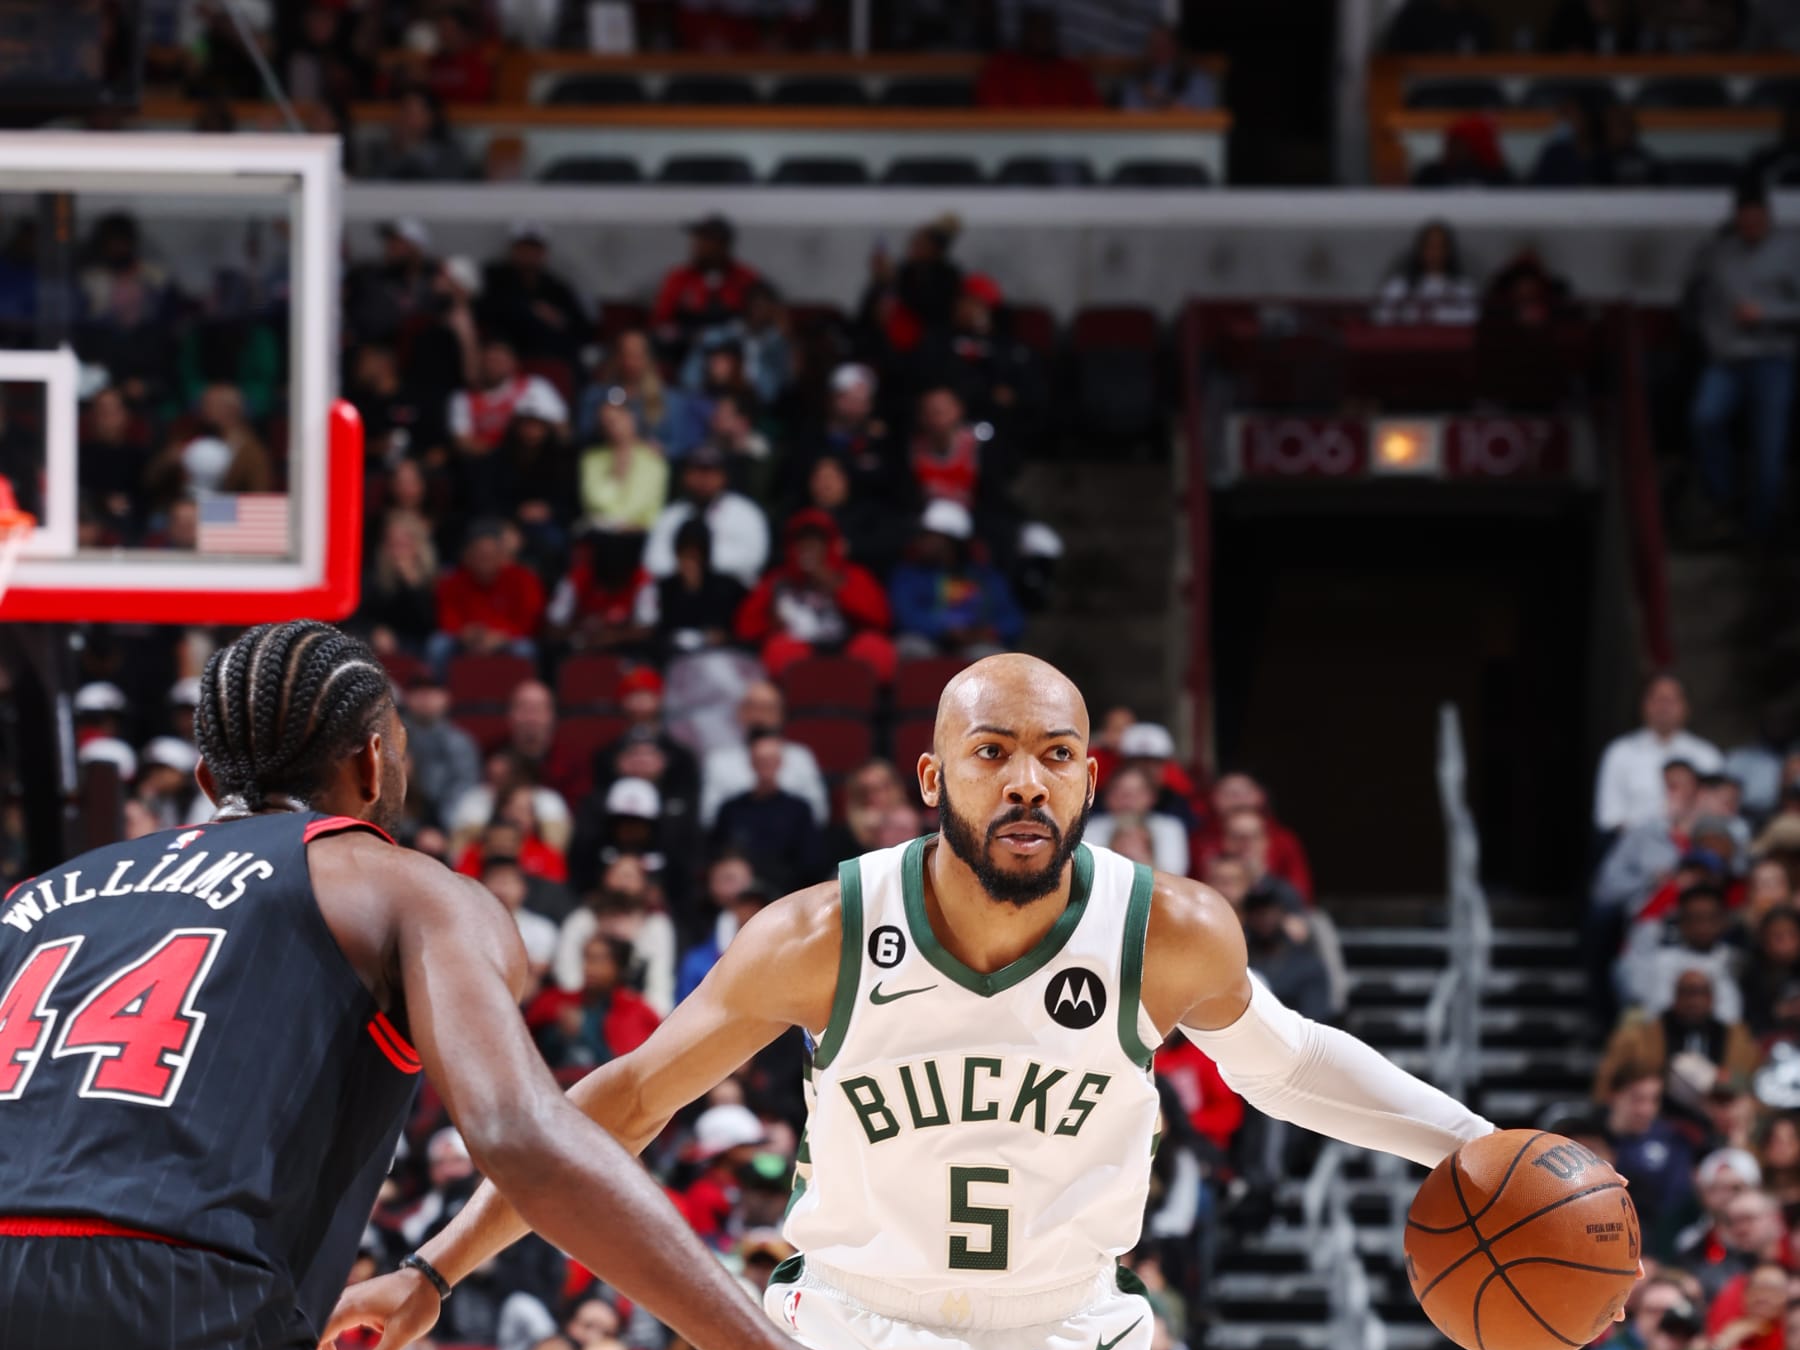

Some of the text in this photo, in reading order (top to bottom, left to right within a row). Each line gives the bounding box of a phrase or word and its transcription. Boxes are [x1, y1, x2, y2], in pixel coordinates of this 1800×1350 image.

[1250, 419, 1358, 476] 106
[1, 850, 274, 934] WILLIAMS
[877, 931, 901, 964] 6
[0, 927, 227, 1108] 44
[839, 1055, 1116, 1146] BUCKS
[946, 1163, 1013, 1272] 5
